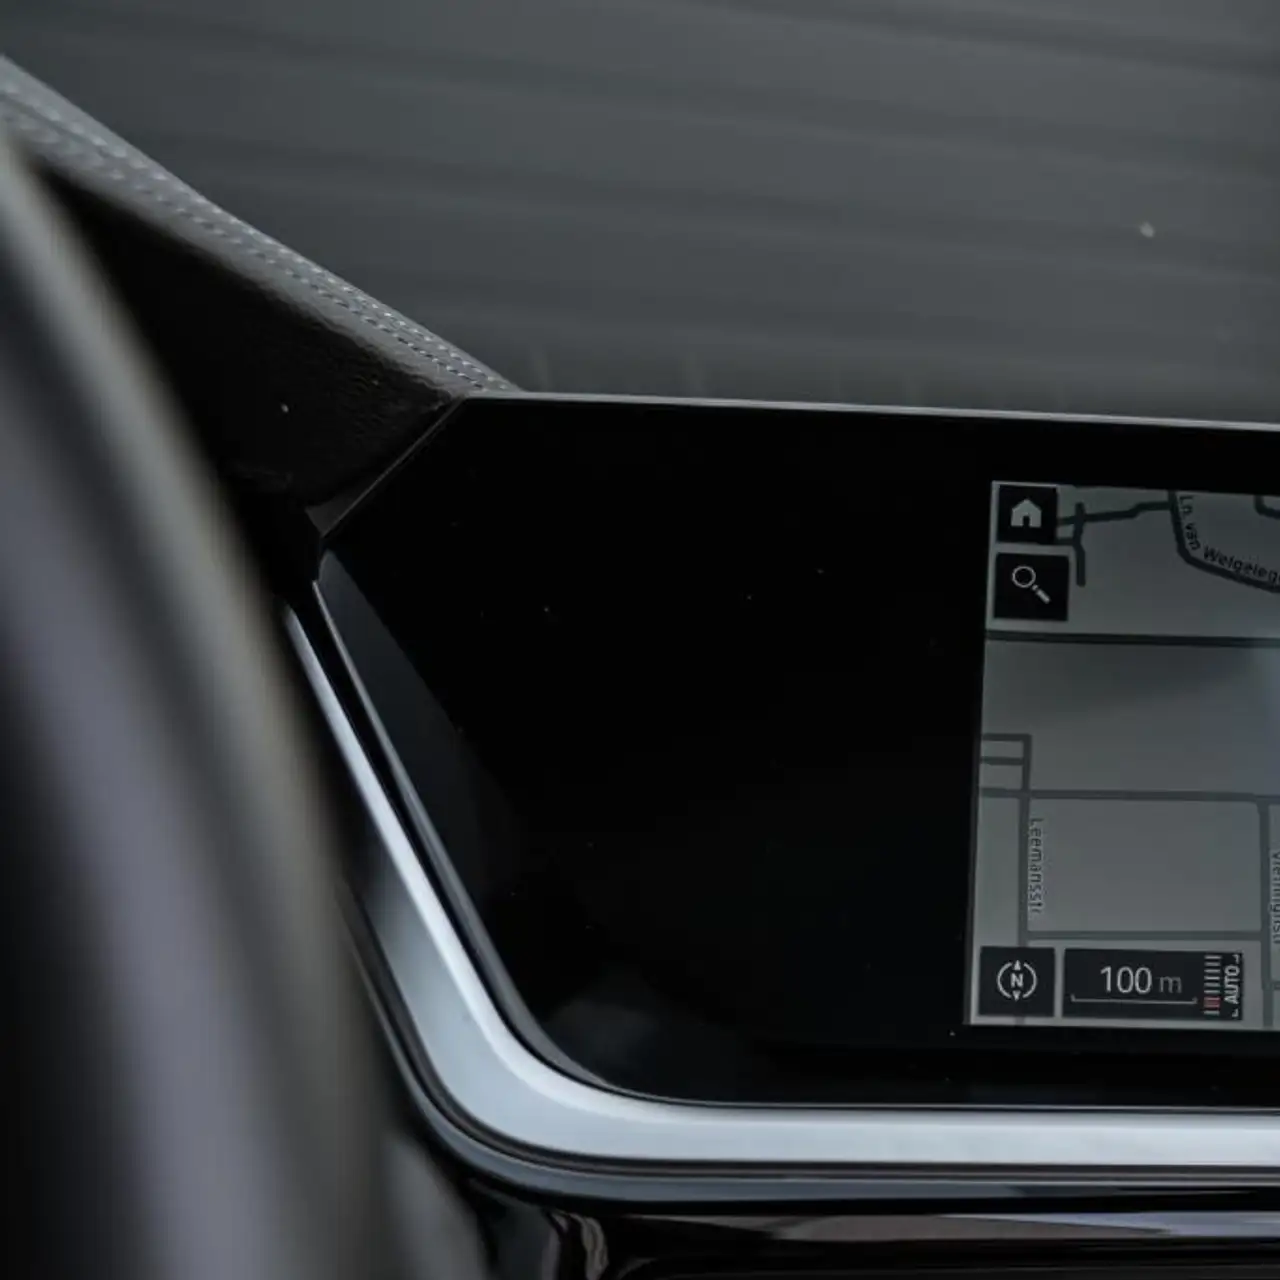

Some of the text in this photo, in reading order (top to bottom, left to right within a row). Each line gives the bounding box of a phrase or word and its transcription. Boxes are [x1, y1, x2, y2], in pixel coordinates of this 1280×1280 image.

[1100, 966, 1182, 995] 100 m
[1224, 964, 1240, 1003] AUTO
